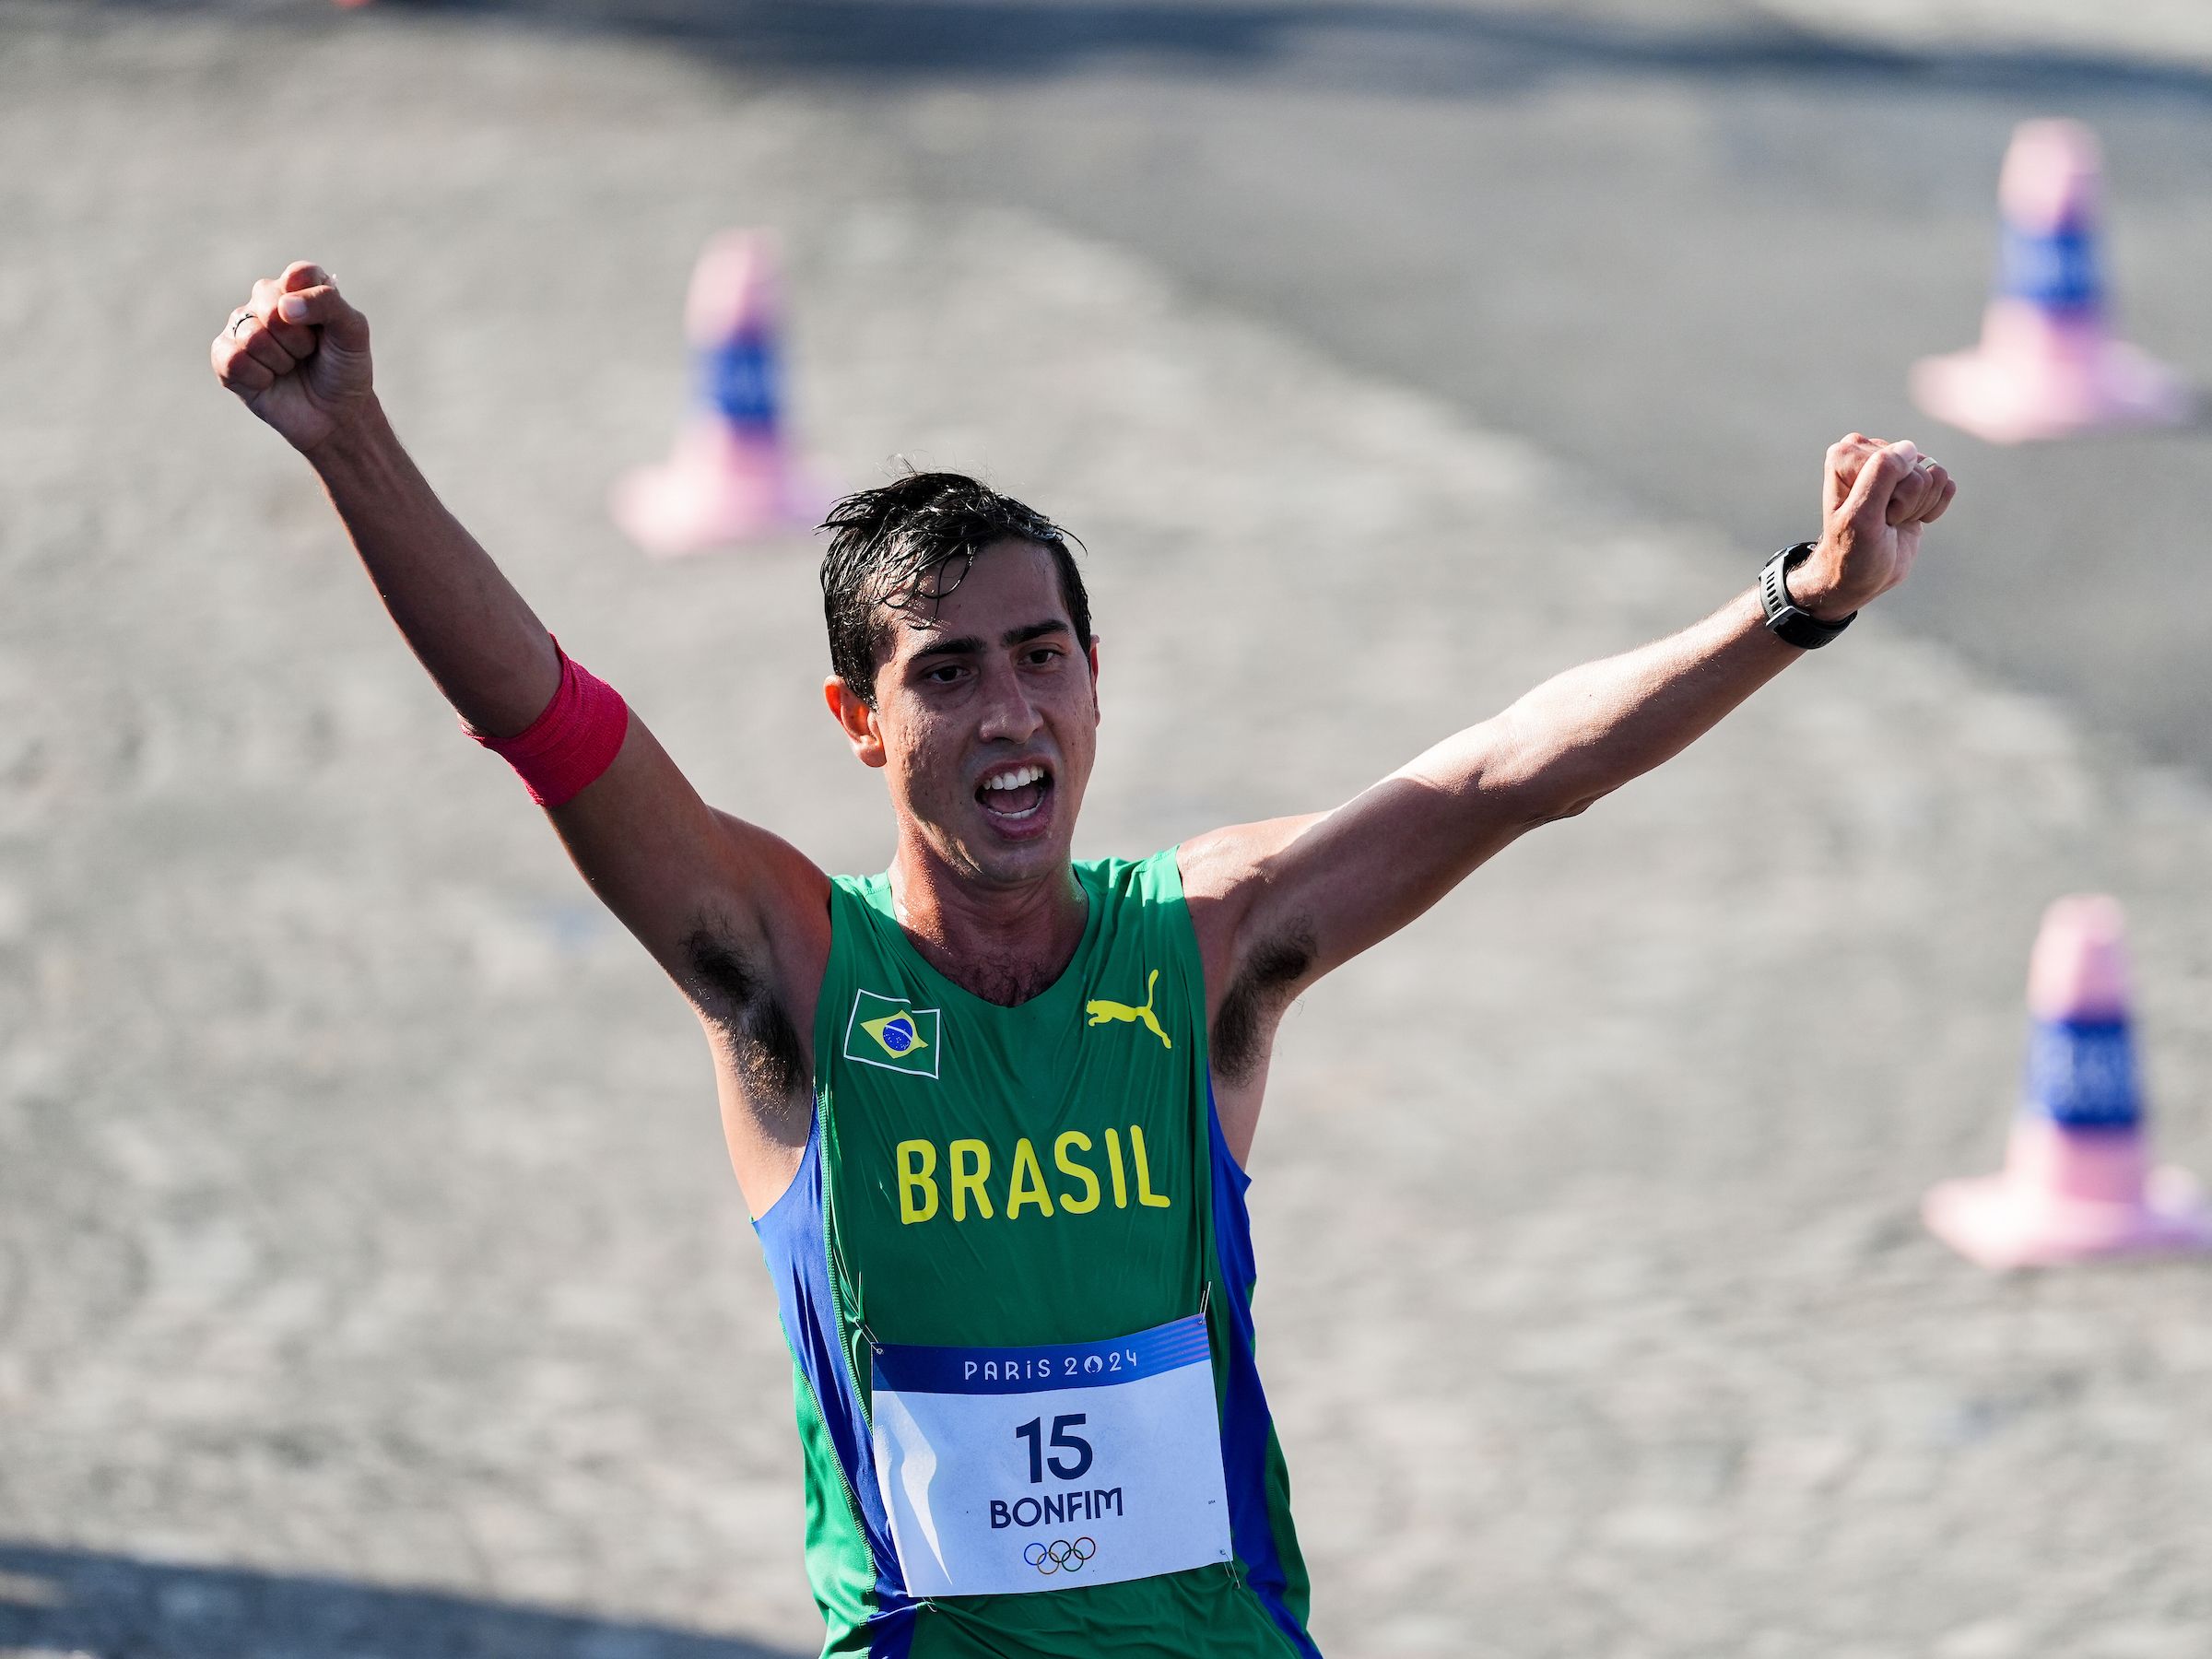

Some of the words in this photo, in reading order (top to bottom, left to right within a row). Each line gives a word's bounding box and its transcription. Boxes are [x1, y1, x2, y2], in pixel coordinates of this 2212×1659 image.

[896, 1124, 1171, 1225] BRASIL
[1064, 1348, 1137, 1376] 2024
[1015, 1413, 1093, 1484] 15
[990, 1487, 1124, 1529] BONFIM
